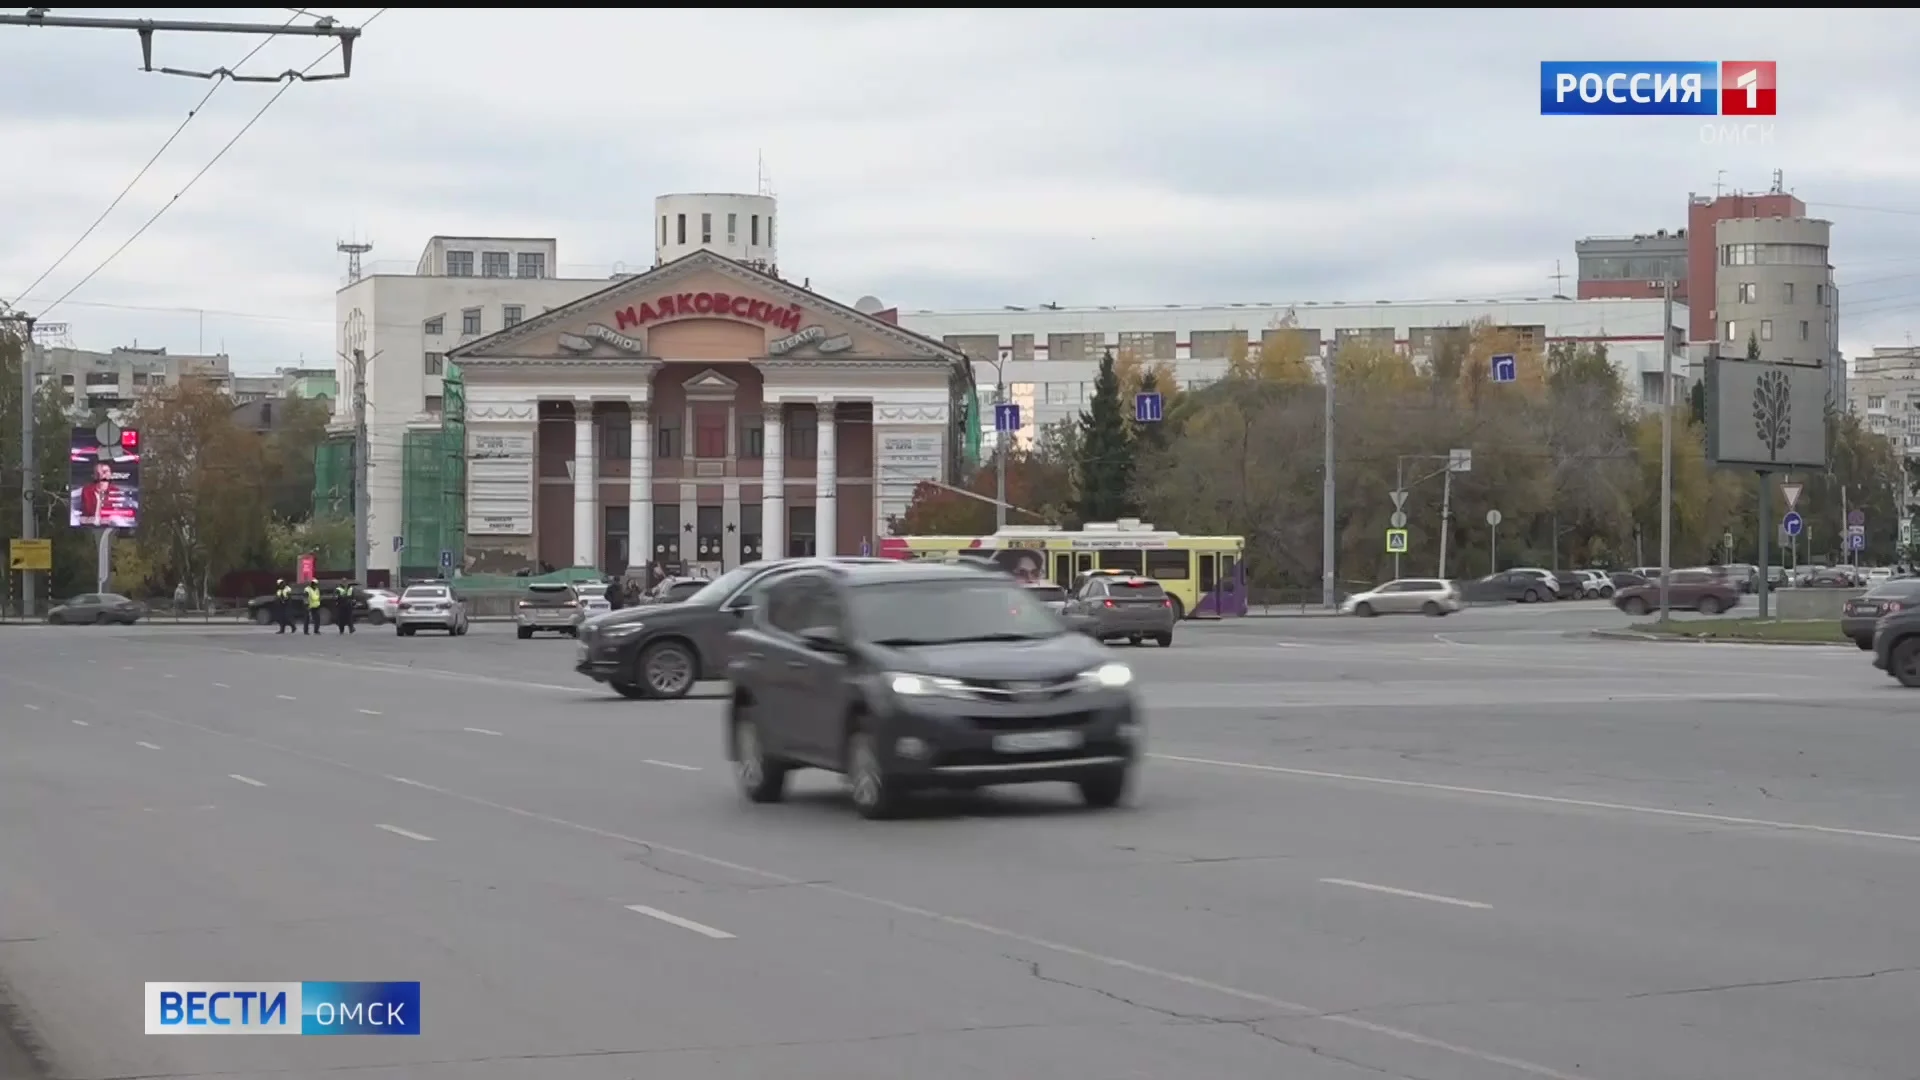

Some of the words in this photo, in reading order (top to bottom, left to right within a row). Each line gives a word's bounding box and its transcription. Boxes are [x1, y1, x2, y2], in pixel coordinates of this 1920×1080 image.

[614, 291, 803, 332] МАЯКОВСКИЙ
[598, 327, 633, 349] КИНО
[778, 326, 817, 350] ТЕАТР
